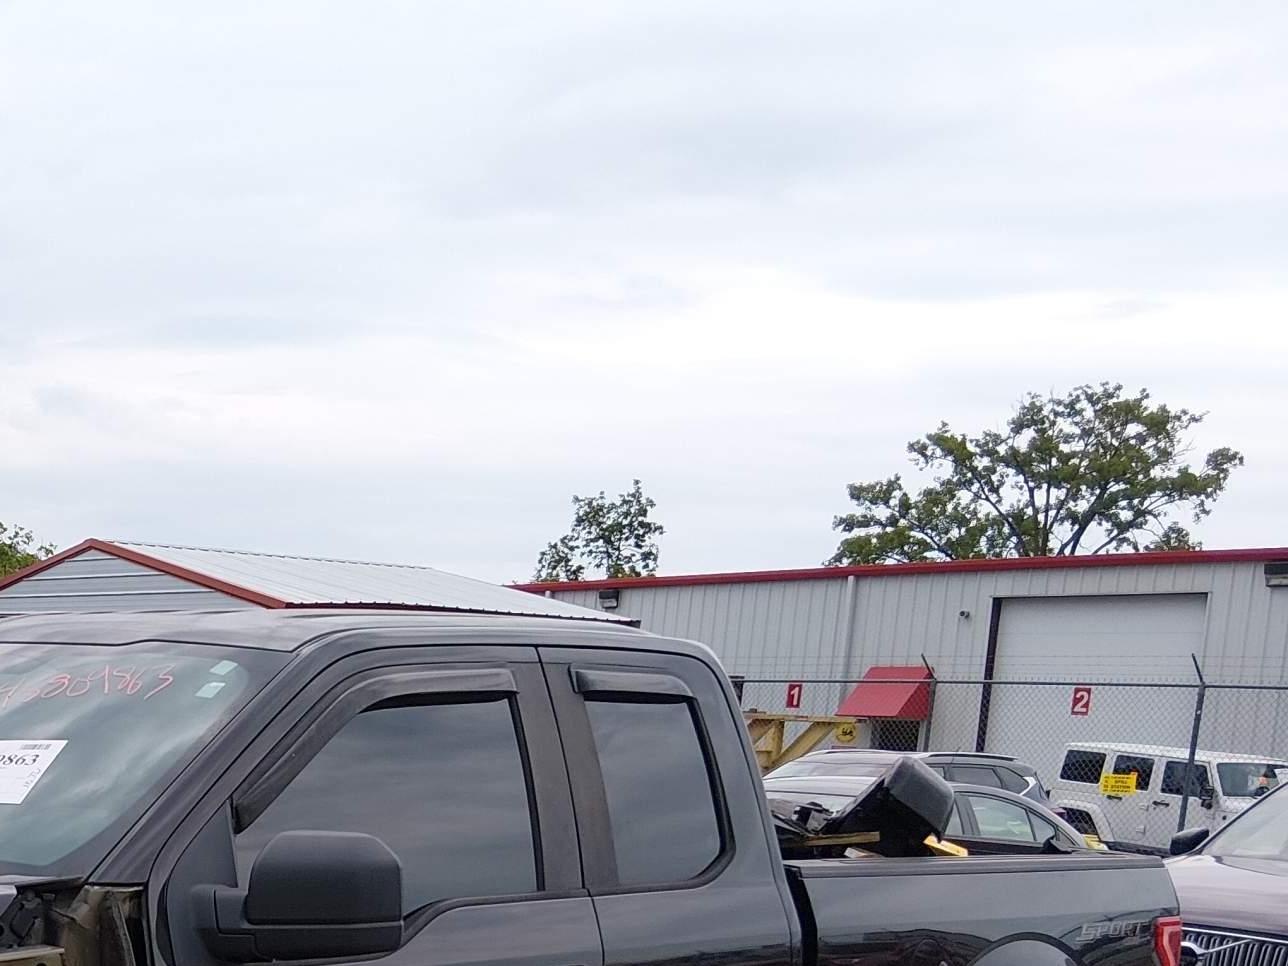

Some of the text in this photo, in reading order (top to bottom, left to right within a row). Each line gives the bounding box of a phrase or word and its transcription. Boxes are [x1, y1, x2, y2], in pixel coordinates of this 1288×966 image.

[790, 686, 800, 706] 1
[1073, 691, 1089, 713] 2
[1075, 920, 1149, 944] SPORT
